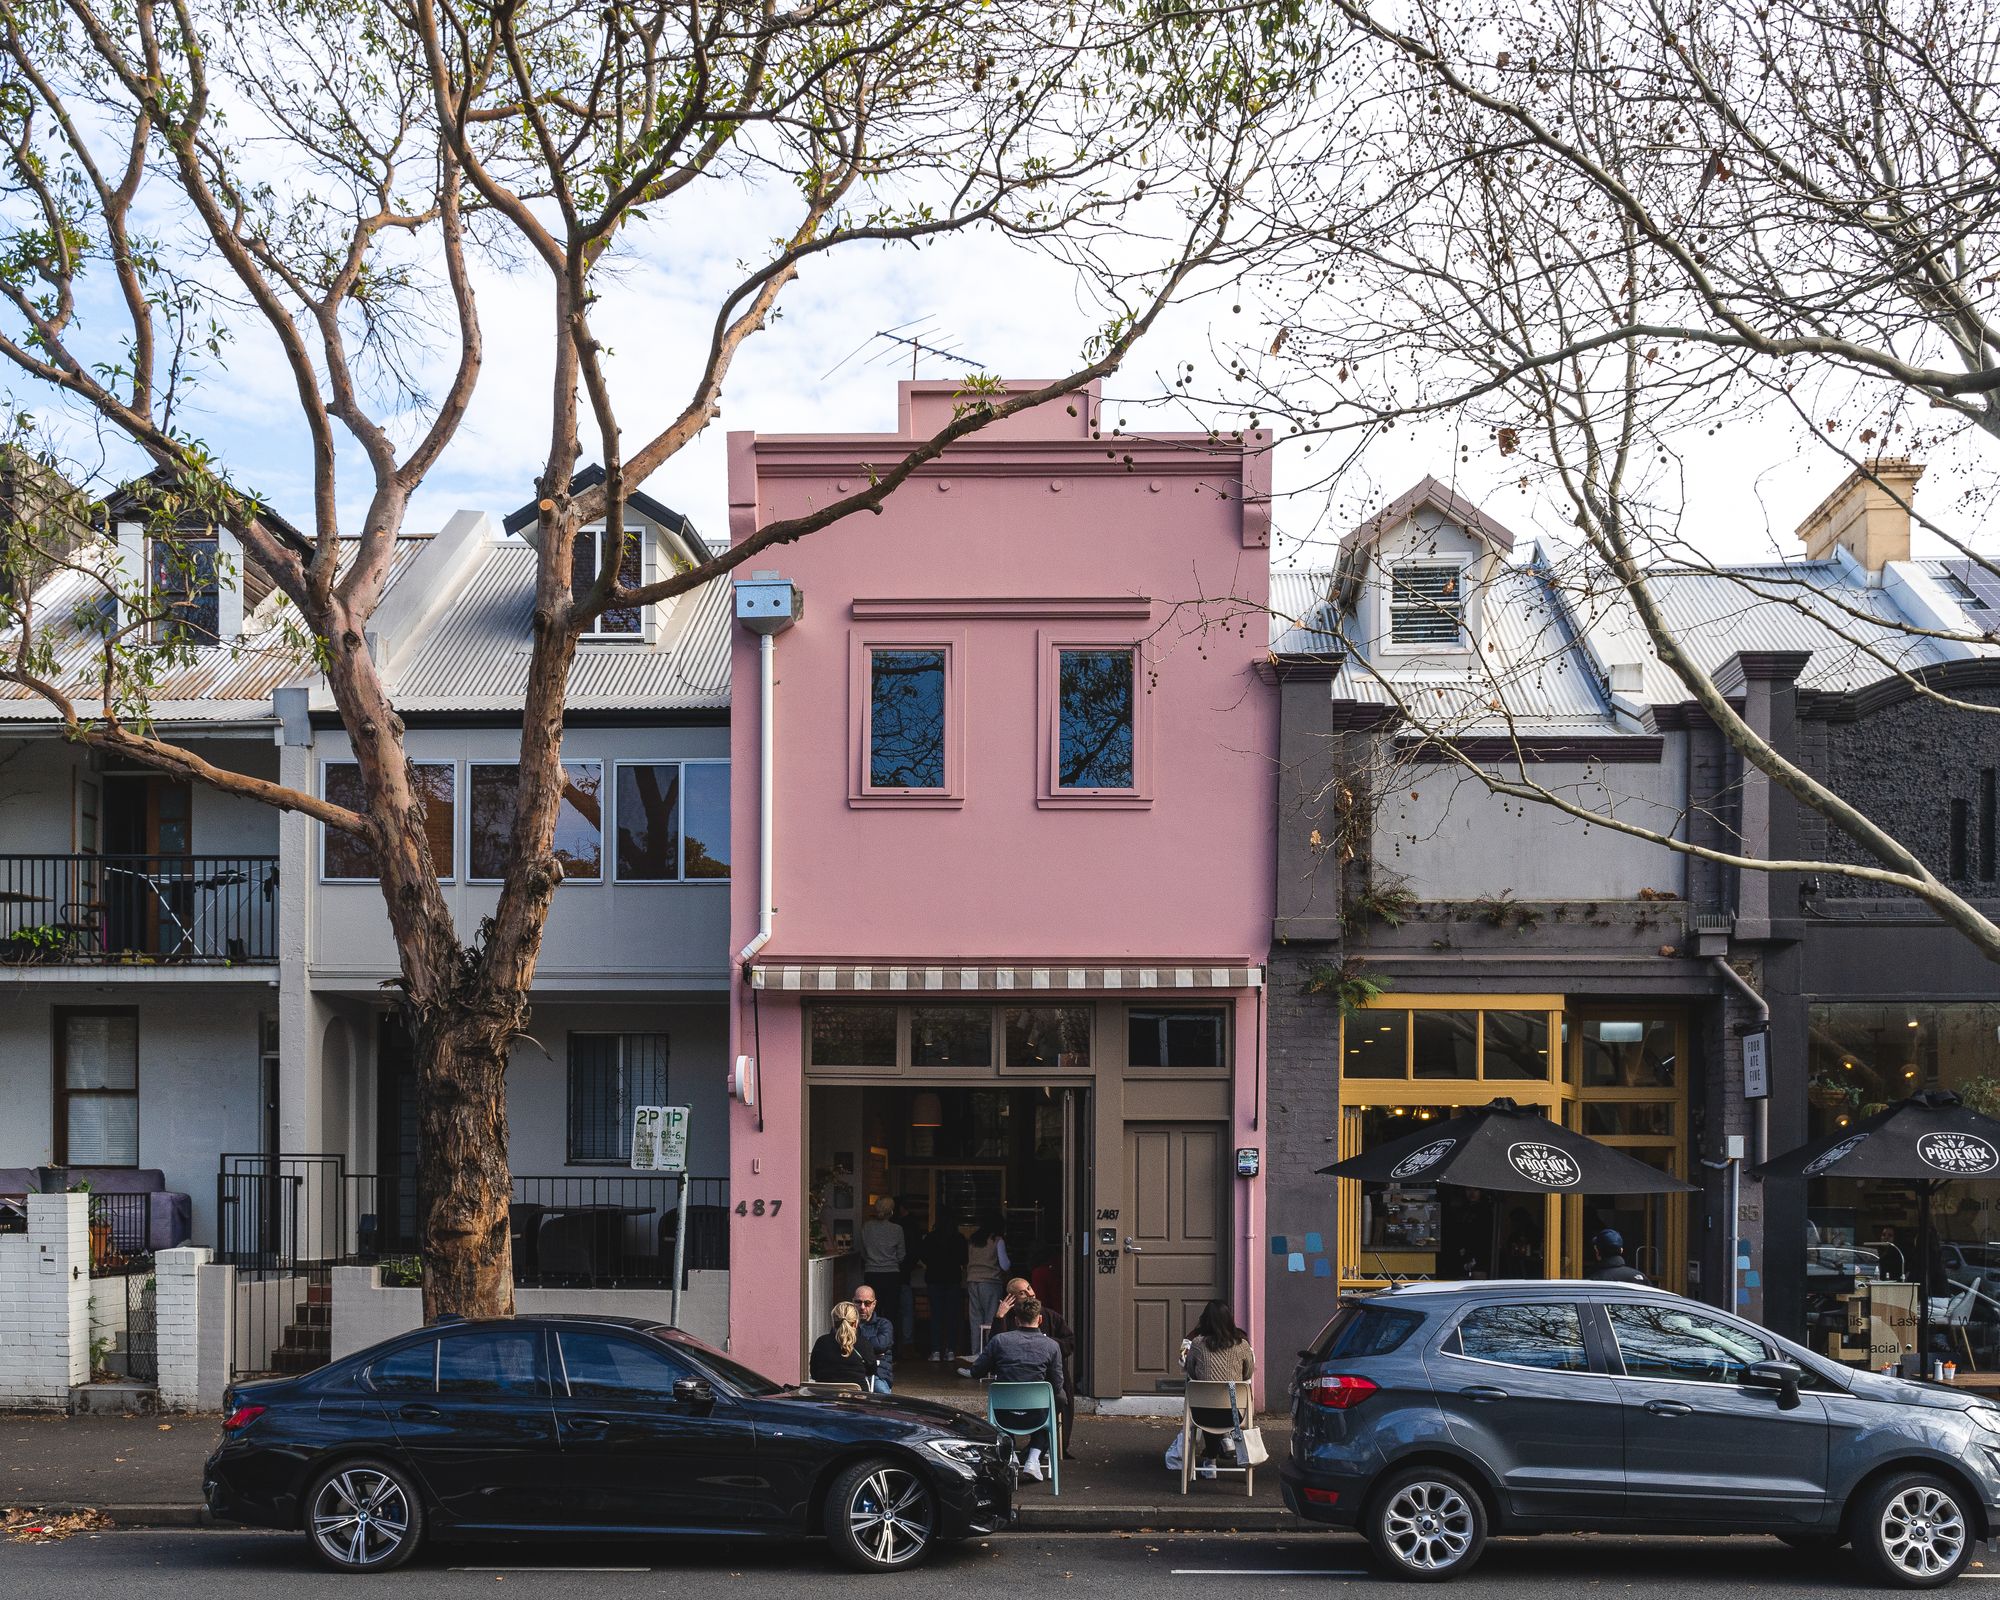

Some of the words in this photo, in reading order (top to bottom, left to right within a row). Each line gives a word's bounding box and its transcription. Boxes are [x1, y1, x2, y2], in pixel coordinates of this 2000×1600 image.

[1748, 1040, 1760, 1053] FOUR
[1750, 1054, 1759, 1067] ATE
[1749, 1069, 1760, 1082] FIVE
[636, 1110, 659, 1125] 2P
[665, 1111, 683, 1127] 1P
[1925, 1147, 1991, 1160] PHOENIX
[1515, 1157, 1573, 1172] PHOENIX
[735, 1198, 783, 1217] 487
[1096, 1209, 1120, 1220] 2/487
[1097, 1257, 1118, 1266] STREET
[1098, 1265, 1116, 1274] LOFT
[1889, 1315, 1936, 1327] Lashs
